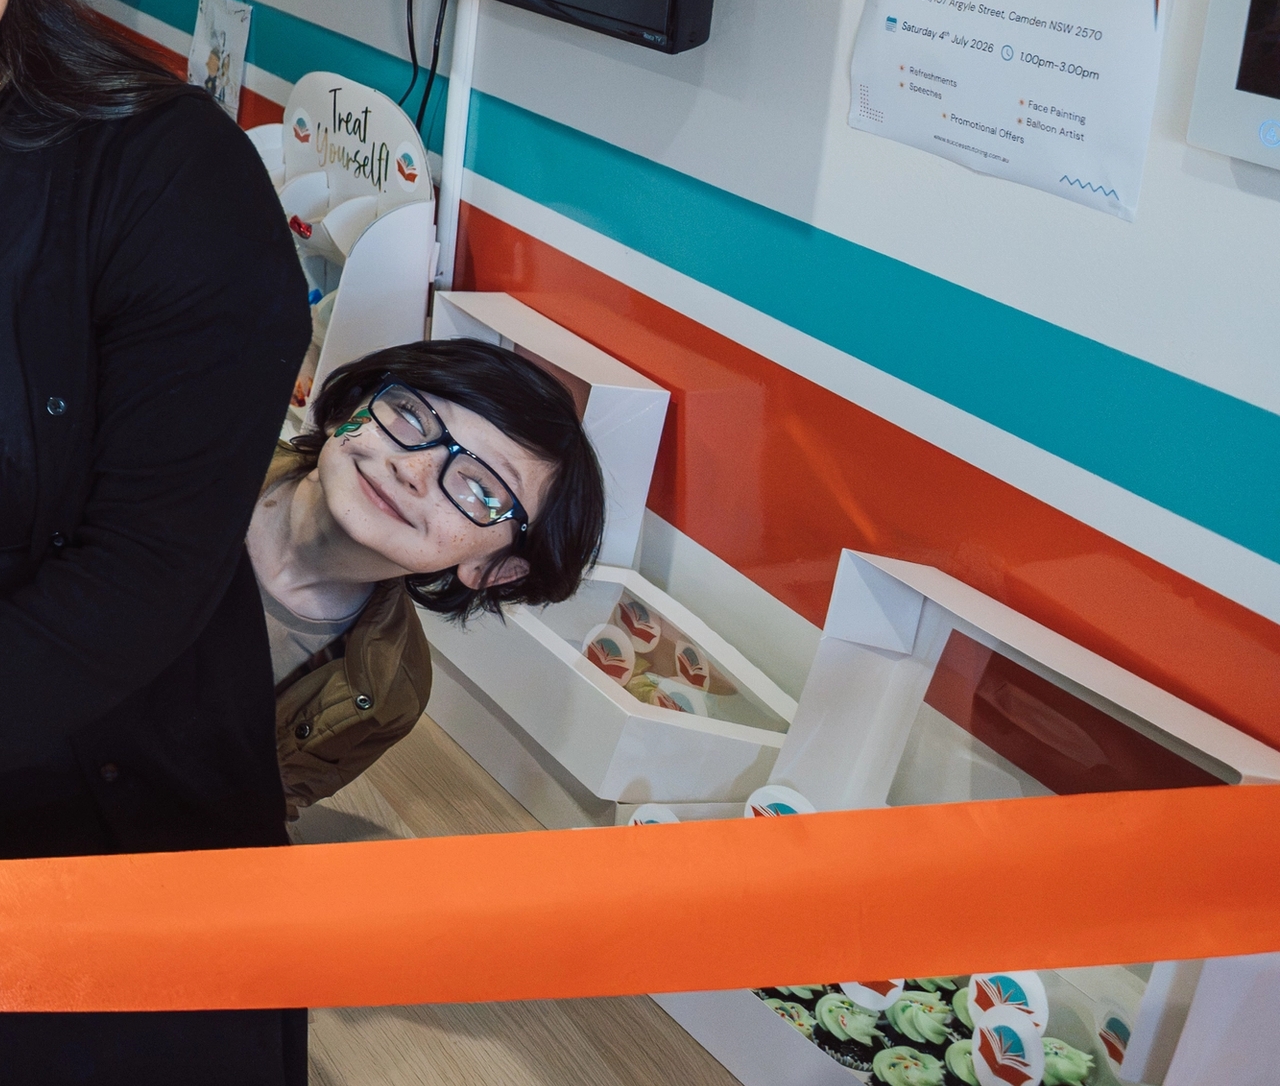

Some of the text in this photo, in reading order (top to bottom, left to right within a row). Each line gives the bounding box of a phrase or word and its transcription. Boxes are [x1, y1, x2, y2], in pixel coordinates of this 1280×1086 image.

[977, 4, 1005, 19] Street,
[1008, 11, 1047, 28] Camden
[1049, 20, 1074, 34] NSW
[1075, 26, 1103, 41] 2570
[901, 21, 937, 40] Saturday
[939, 30, 950, 40] 4th
[951, 34, 969, 48] July
[970, 38, 995, 53] 2026
[909, 66, 958, 88] Refreshments
[909, 82, 942, 100] Speeches
[329, 87, 372, 144] Treat
[1028, 100, 1086, 126] Face Painting
[950, 113, 1025, 144] Promotional Offers
[1026, 117, 1085, 142] Balloon Artist
